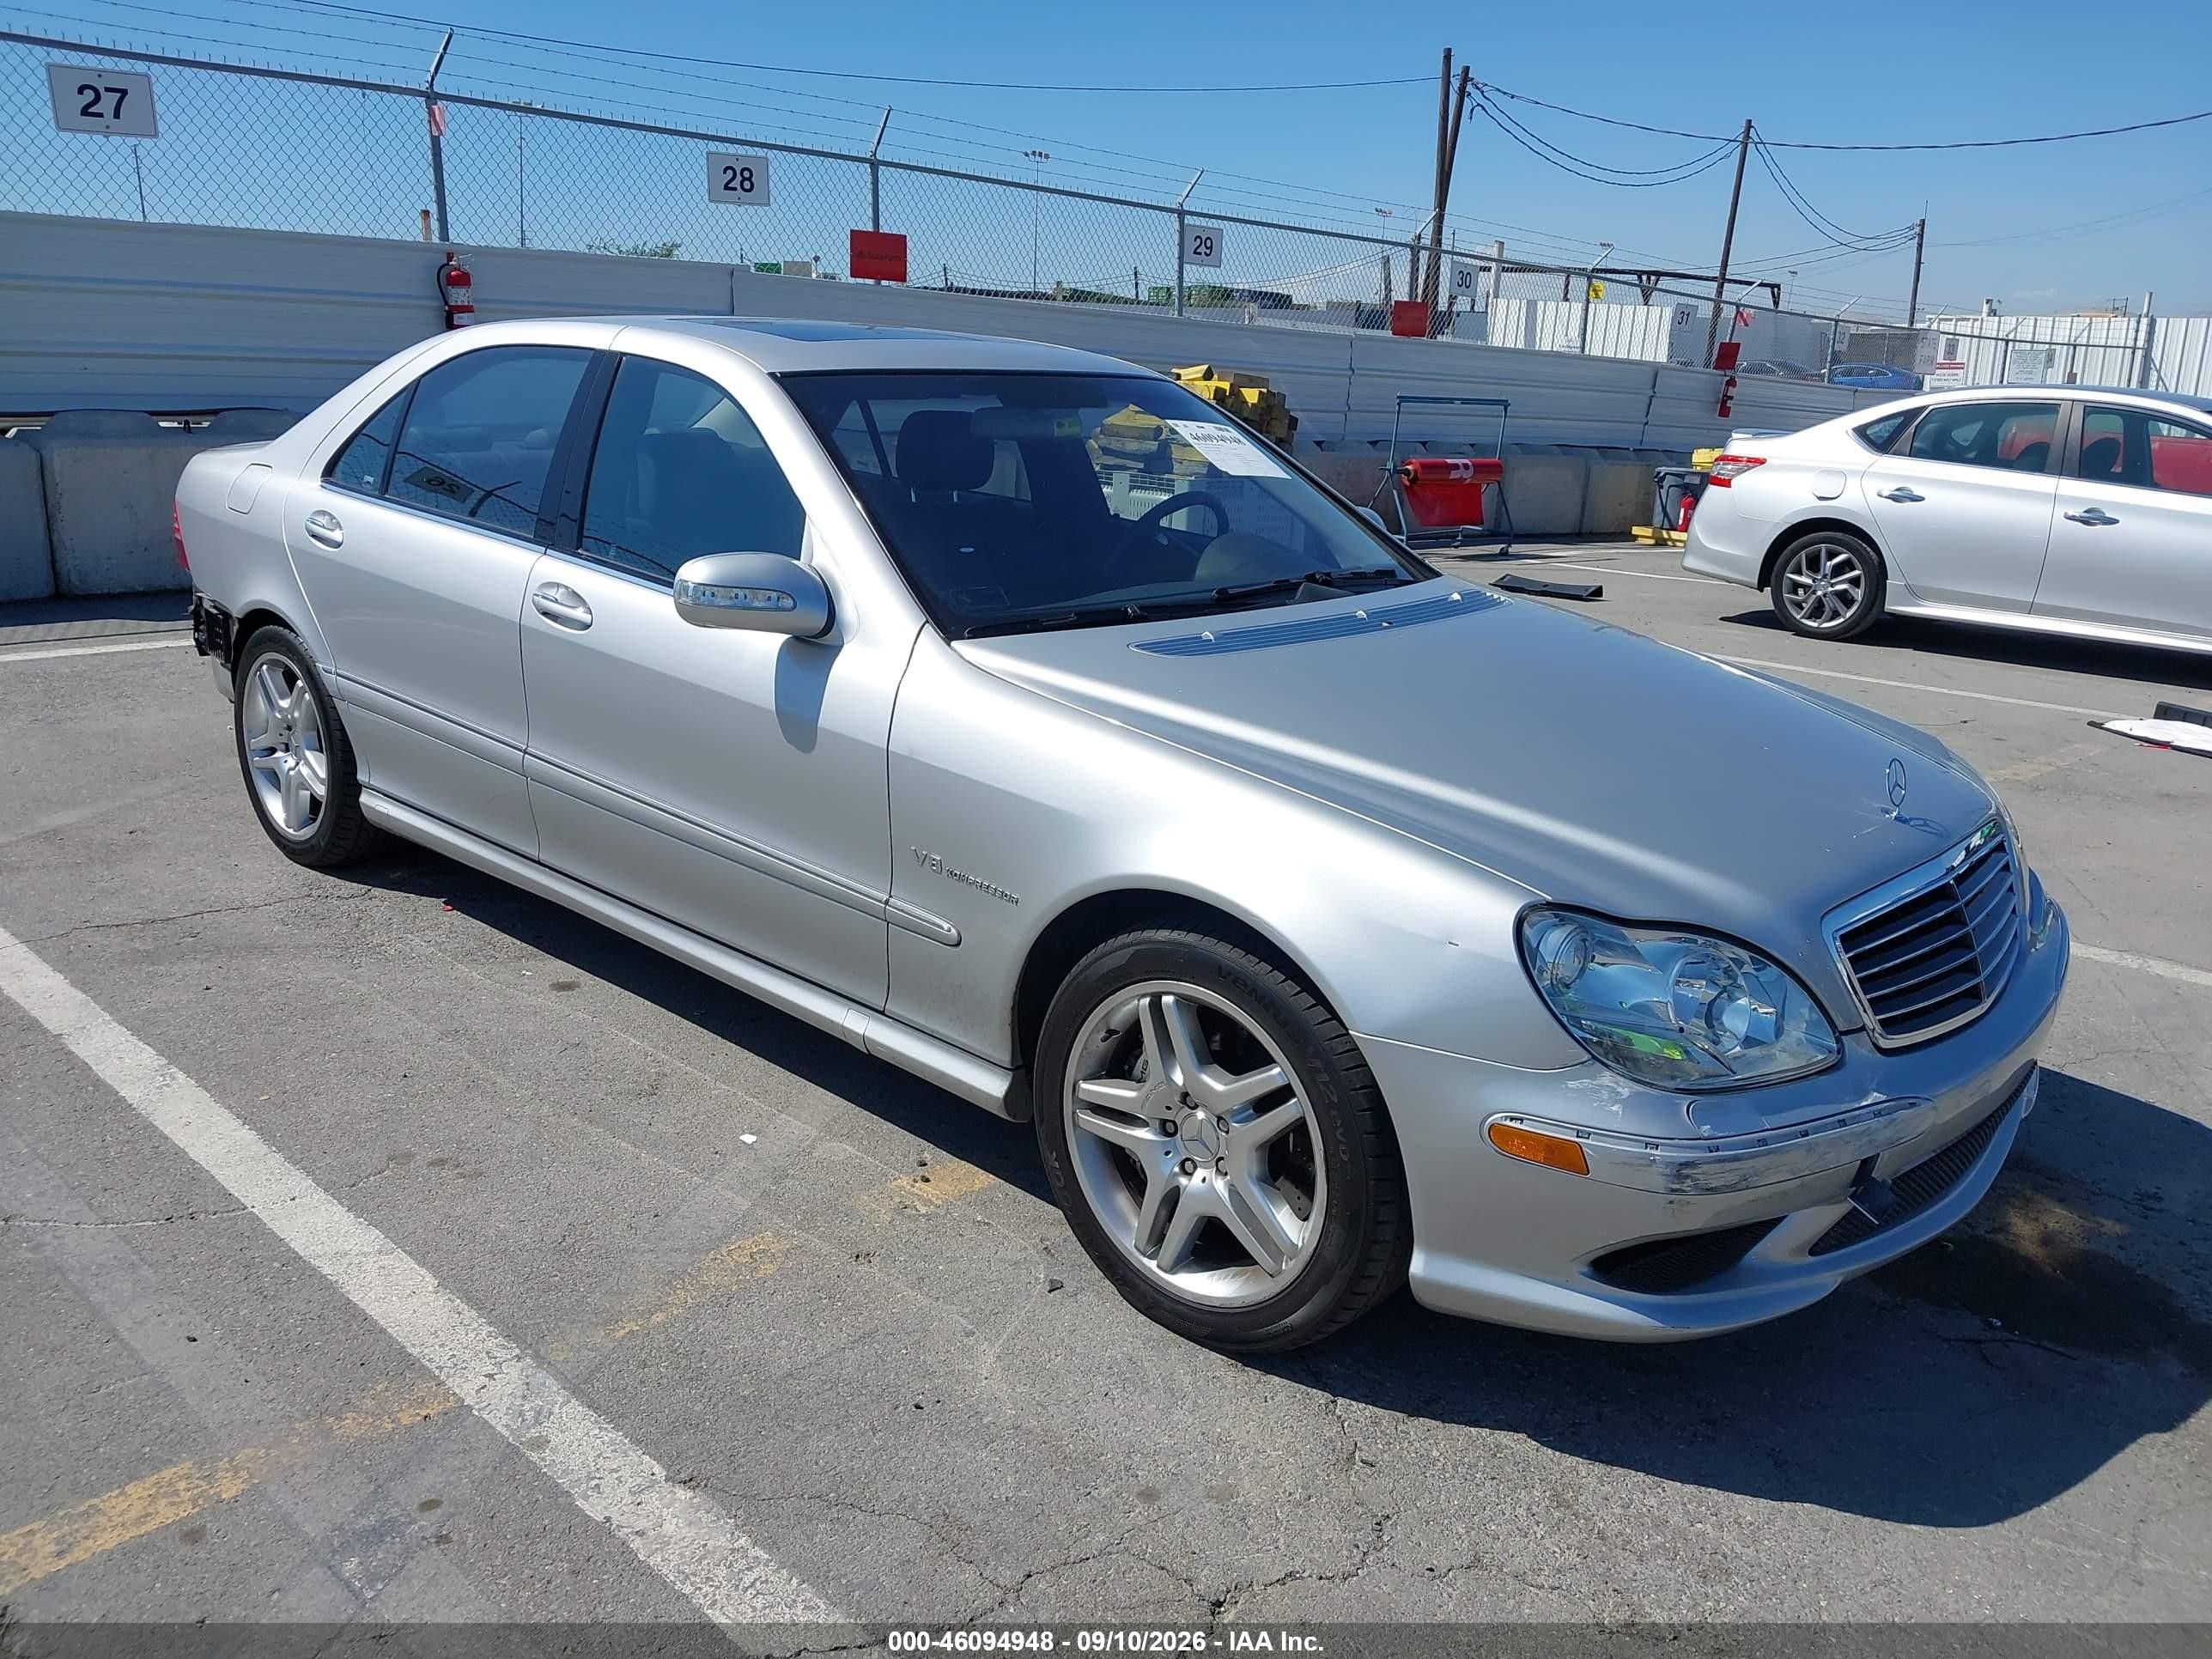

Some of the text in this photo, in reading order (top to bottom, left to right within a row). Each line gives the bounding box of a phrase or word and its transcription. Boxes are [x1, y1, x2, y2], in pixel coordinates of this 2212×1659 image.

[76, 83, 129, 120] 27
[722, 165, 755, 193] 28
[1192, 234, 1213, 258] 29
[1456, 270, 1472, 289] 30
[1677, 310, 1691, 326] 31
[1947, 343, 1955, 356] 33
[909, 844, 944, 875] V8
[1137, 1058, 1149, 1083] MG
